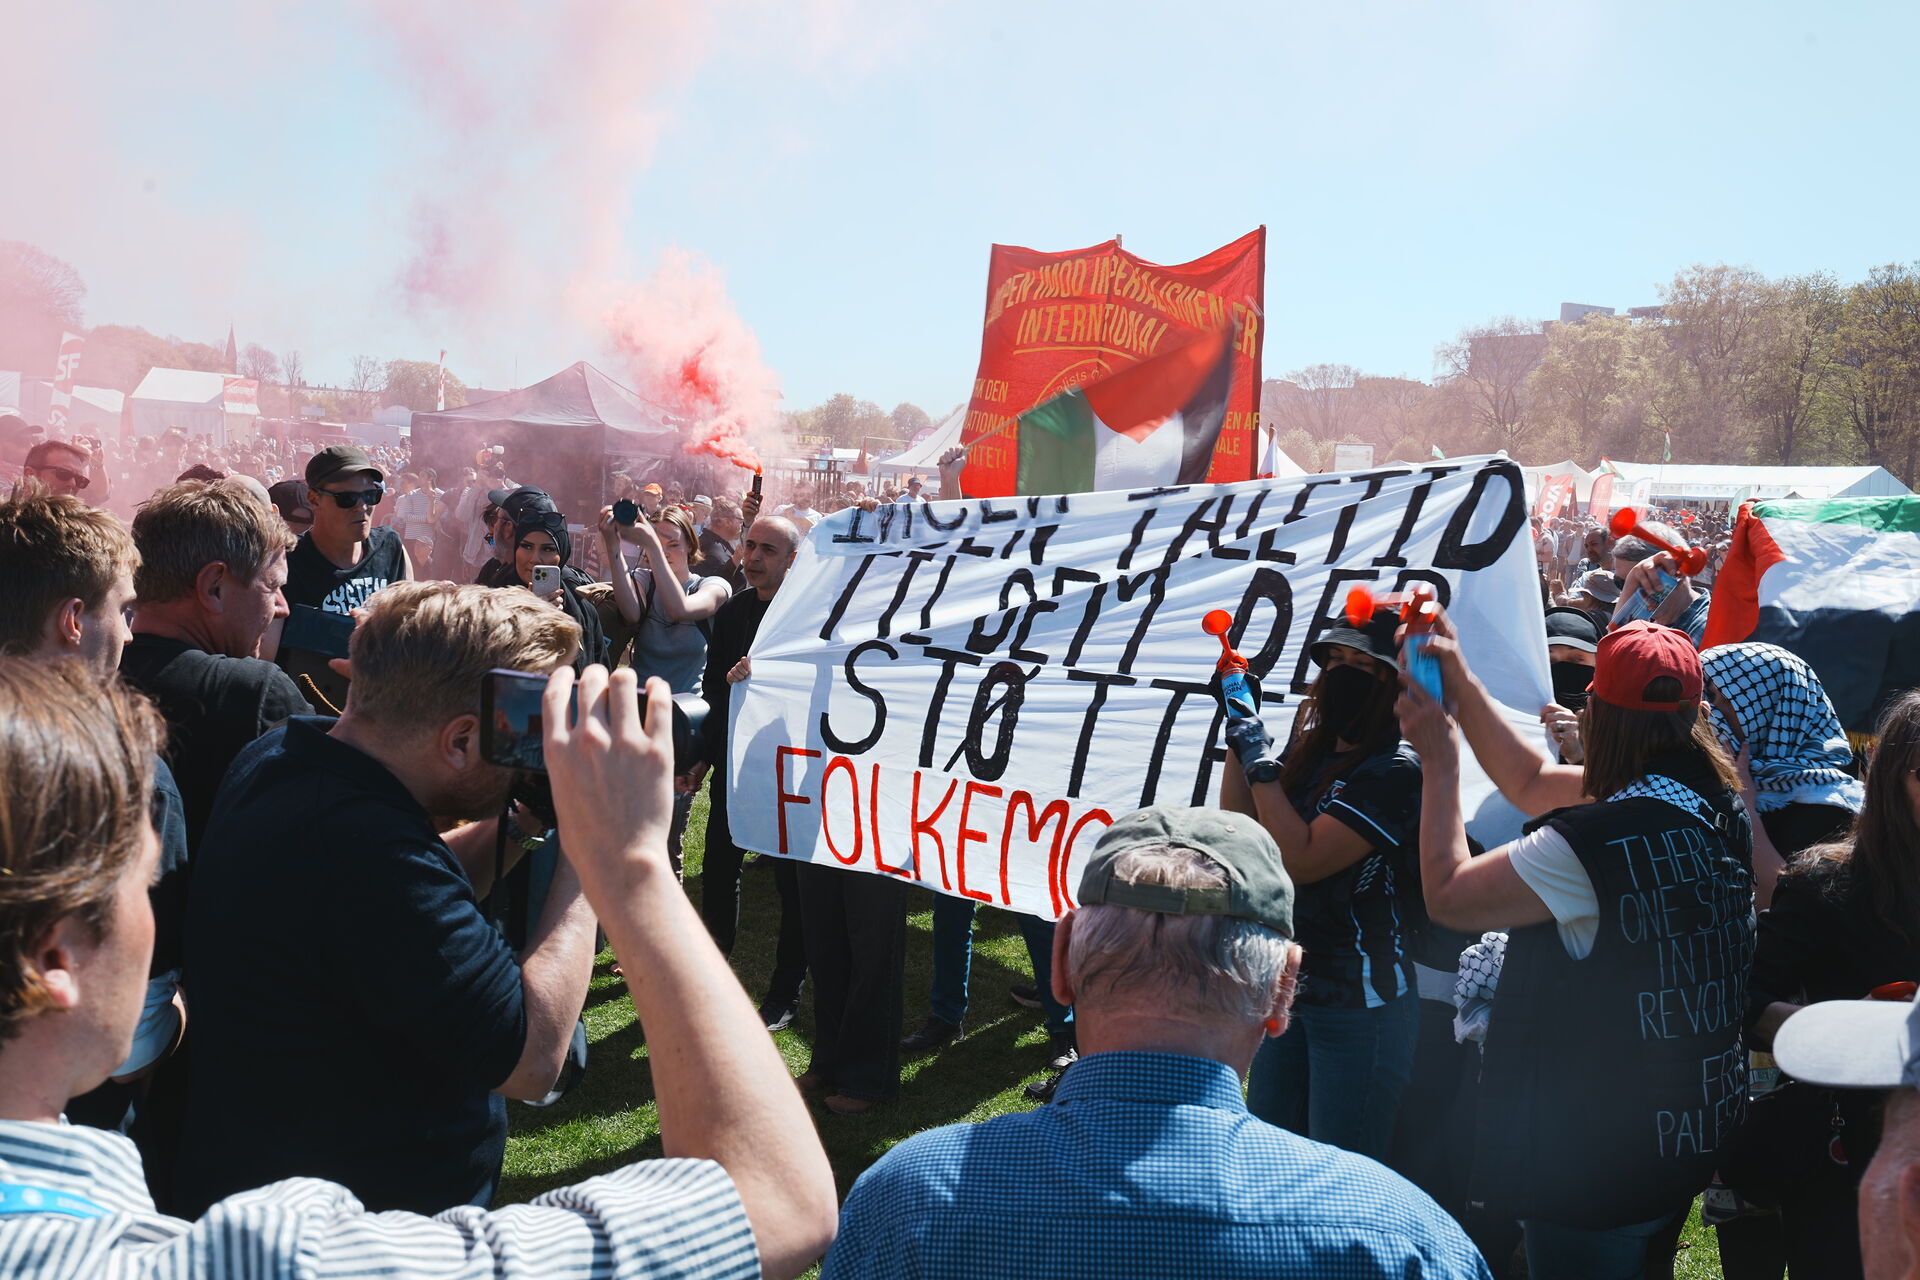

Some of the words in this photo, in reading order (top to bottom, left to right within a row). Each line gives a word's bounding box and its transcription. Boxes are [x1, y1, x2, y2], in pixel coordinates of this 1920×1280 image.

[56, 353, 80, 381] SF
[985, 379, 1009, 402] DEN
[1117, 458, 1527, 572] TALETID
[820, 639, 1297, 808] STØTTE
[776, 744, 1114, 918] FOLKEMO
[1620, 885, 1685, 943] ONE
